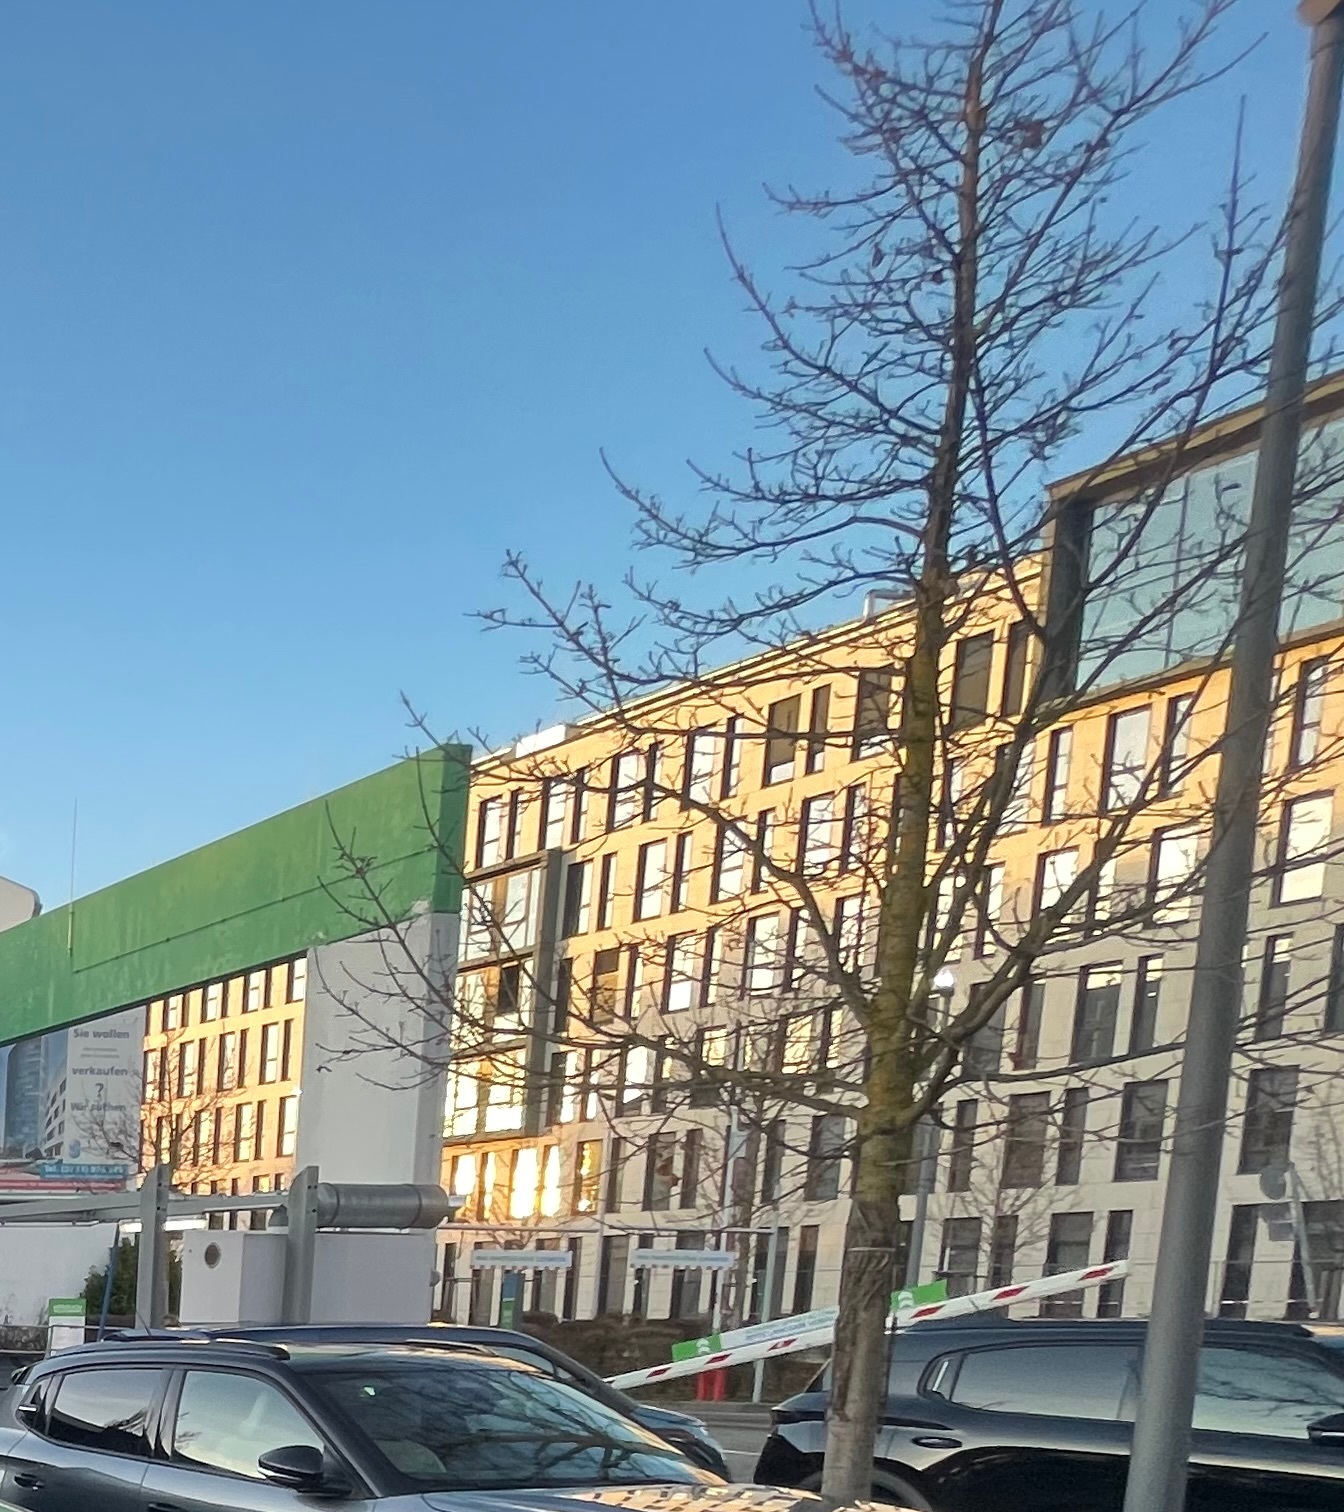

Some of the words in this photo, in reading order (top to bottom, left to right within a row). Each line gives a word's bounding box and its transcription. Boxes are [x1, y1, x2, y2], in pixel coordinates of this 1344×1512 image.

[73, 1028, 89, 1038] Sie
[93, 1029, 130, 1039] wollen
[72, 1066, 128, 1076] verkaufen
[95, 1082, 104, 1098] ?
